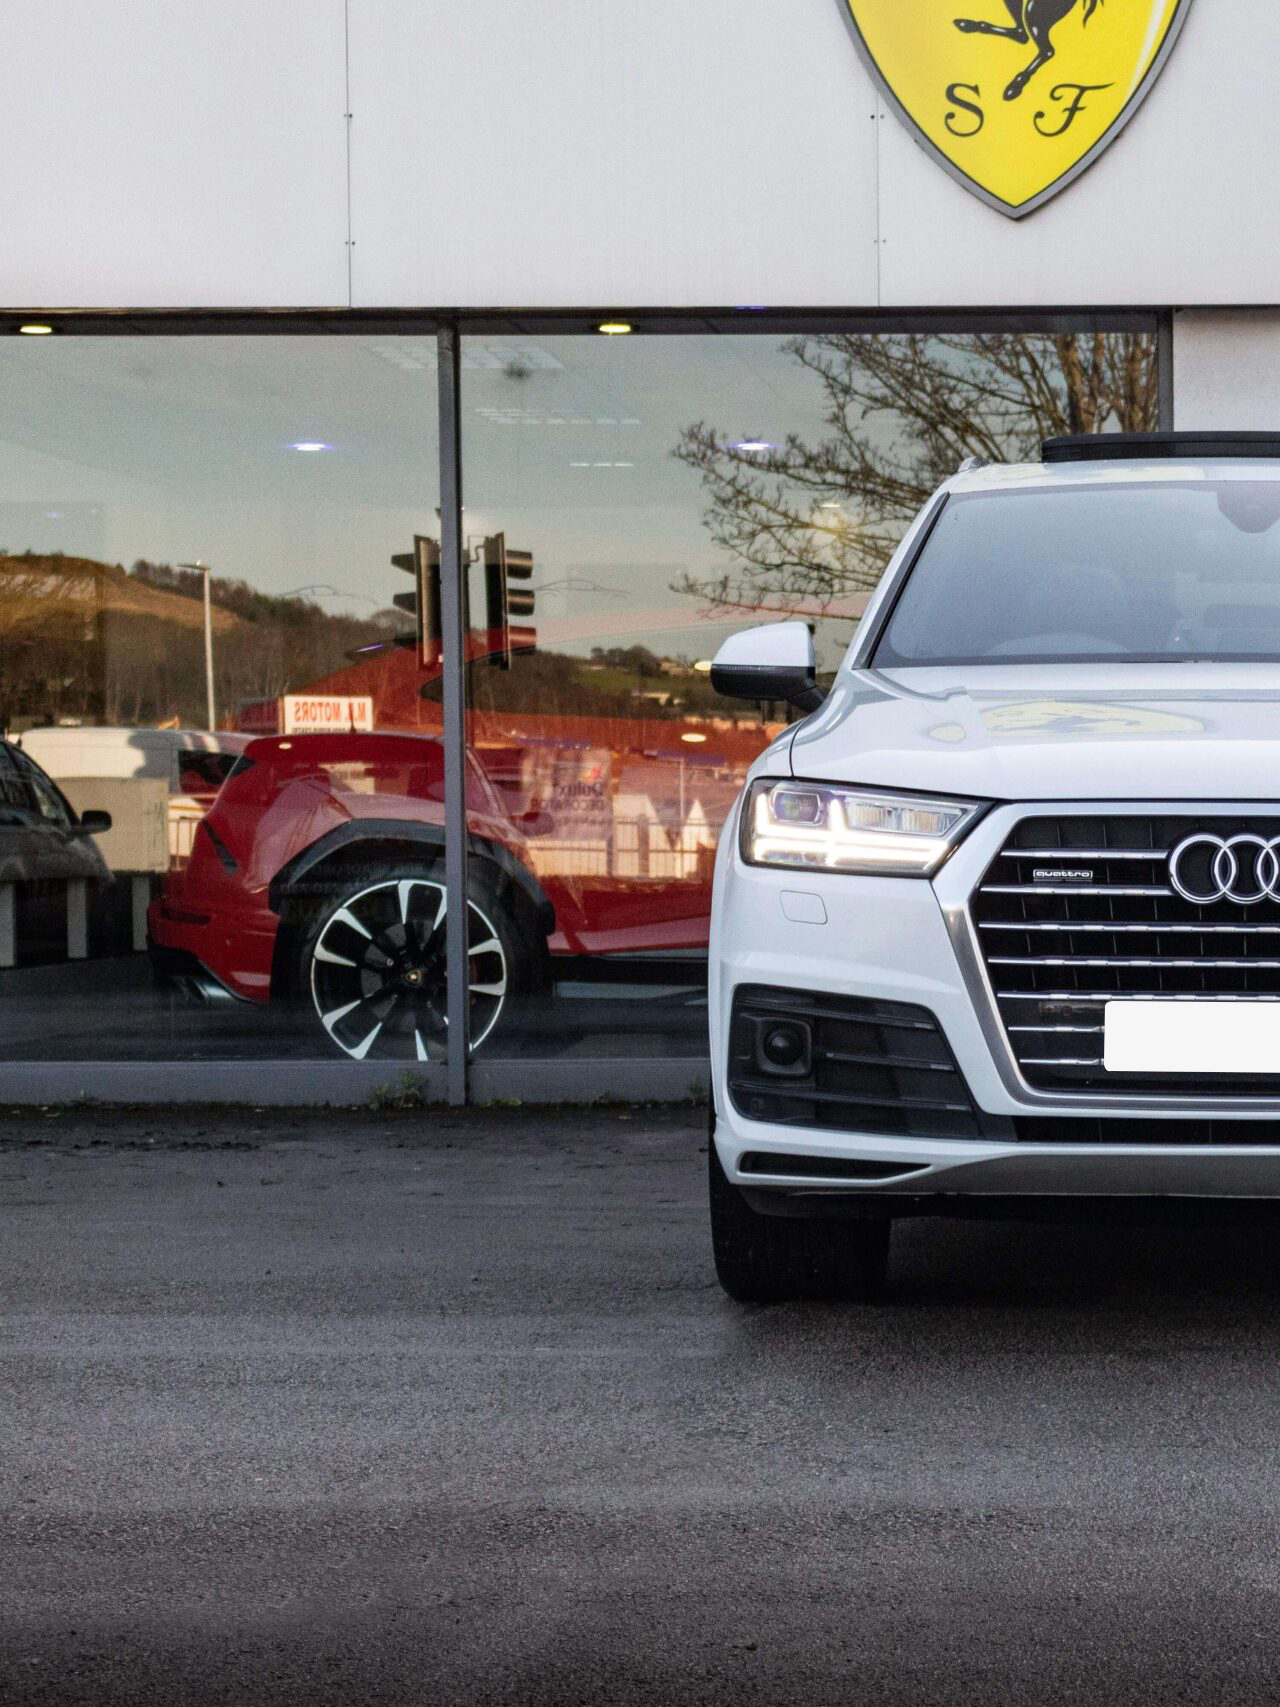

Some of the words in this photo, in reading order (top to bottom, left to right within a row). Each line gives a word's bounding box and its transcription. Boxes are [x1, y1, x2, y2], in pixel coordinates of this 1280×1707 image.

[945, 83, 984, 137] S
[1033, 82, 1115, 137] F
[1035, 870, 1090, 878] quattro
